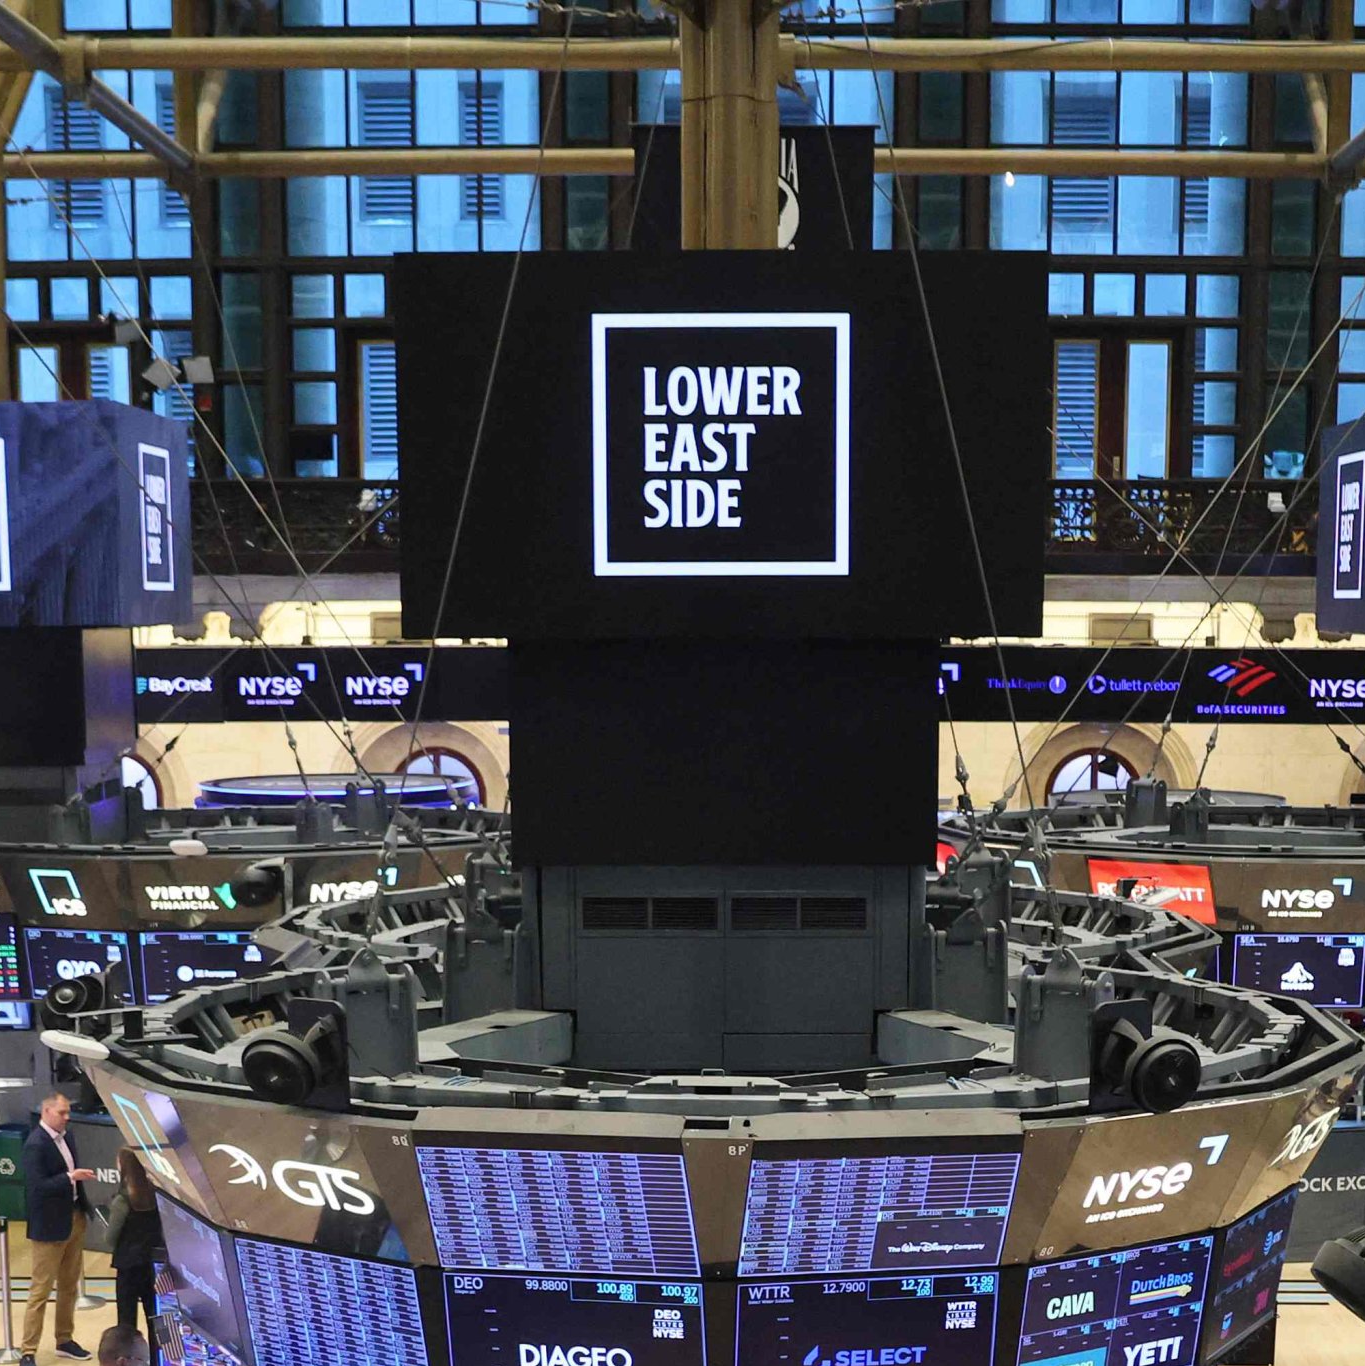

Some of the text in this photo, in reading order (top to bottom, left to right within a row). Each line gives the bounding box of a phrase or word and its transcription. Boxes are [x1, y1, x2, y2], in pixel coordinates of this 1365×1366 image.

[643, 366, 802, 416] LOWER
[643, 423, 756, 472] EAST
[643, 479, 741, 529] SIDE
[148, 676, 213, 696] BayCrest
[1109, 679, 1142, 691] tullett
[1197, 704, 1285, 715] BofA SECURITIES
[145, 885, 210, 901] VIRTU
[1262, 889, 1335, 909] NYSE
[150, 900, 220, 911] FINANCIAL
[272, 1159, 375, 1215] GTS
[1082, 1161, 1194, 1208] NYSE
[453, 1277, 697, 1297] DEO 99.8800 100.89 100.97
[749, 1275, 994, 1300] WTTR 12.7900 12.73 12.99
[654, 1309, 680, 1319] DEO
[947, 1301, 977, 1310] WTTR
[1046, 1291, 1094, 1320] CAVA
[653, 1328, 684, 1339] NYSE
[945, 1318, 976, 1329] NYSE
